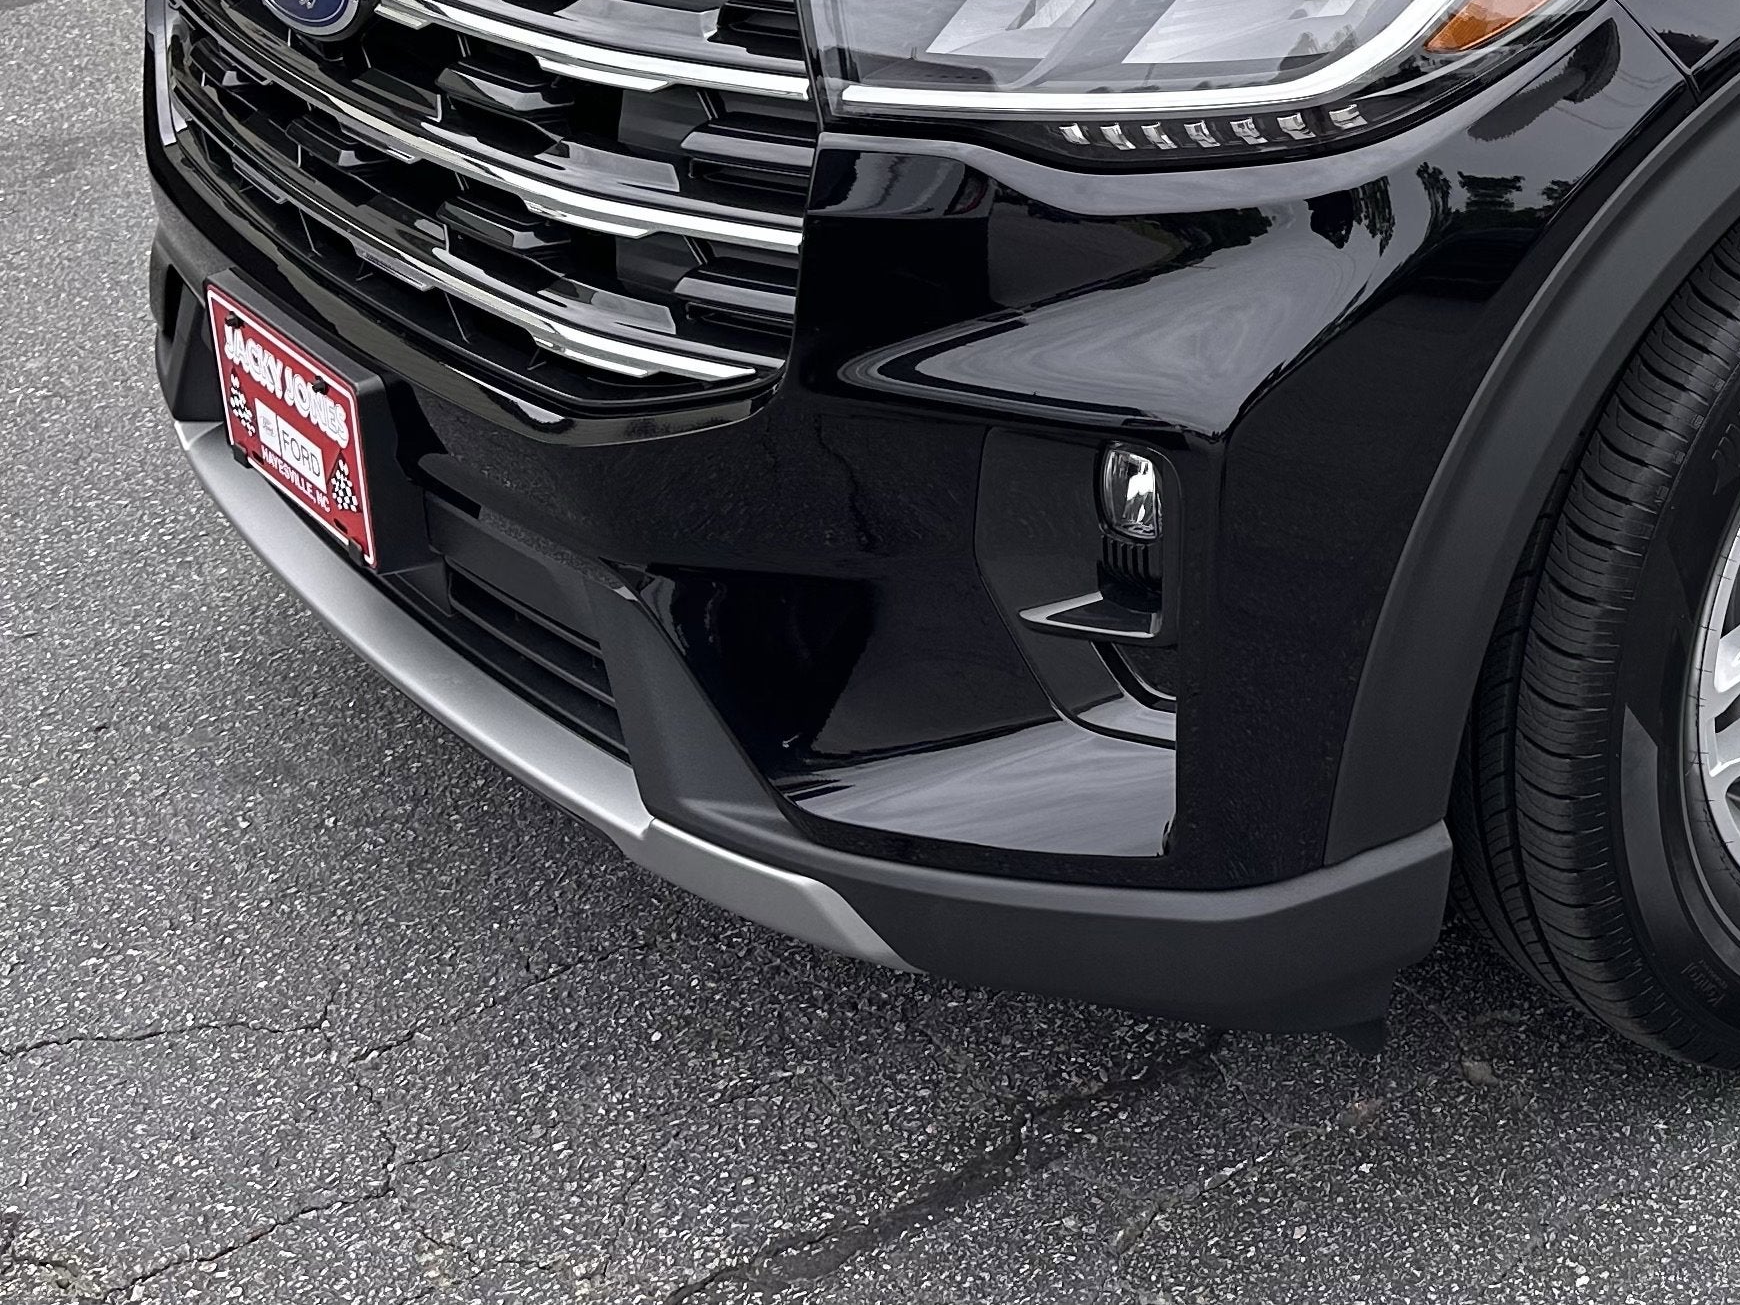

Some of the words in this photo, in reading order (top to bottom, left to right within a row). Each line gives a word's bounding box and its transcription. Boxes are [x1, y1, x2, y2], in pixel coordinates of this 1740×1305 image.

[223, 323, 284, 400] JACKY
[284, 367, 350, 449] JONES
[282, 429, 321, 478] FORD
